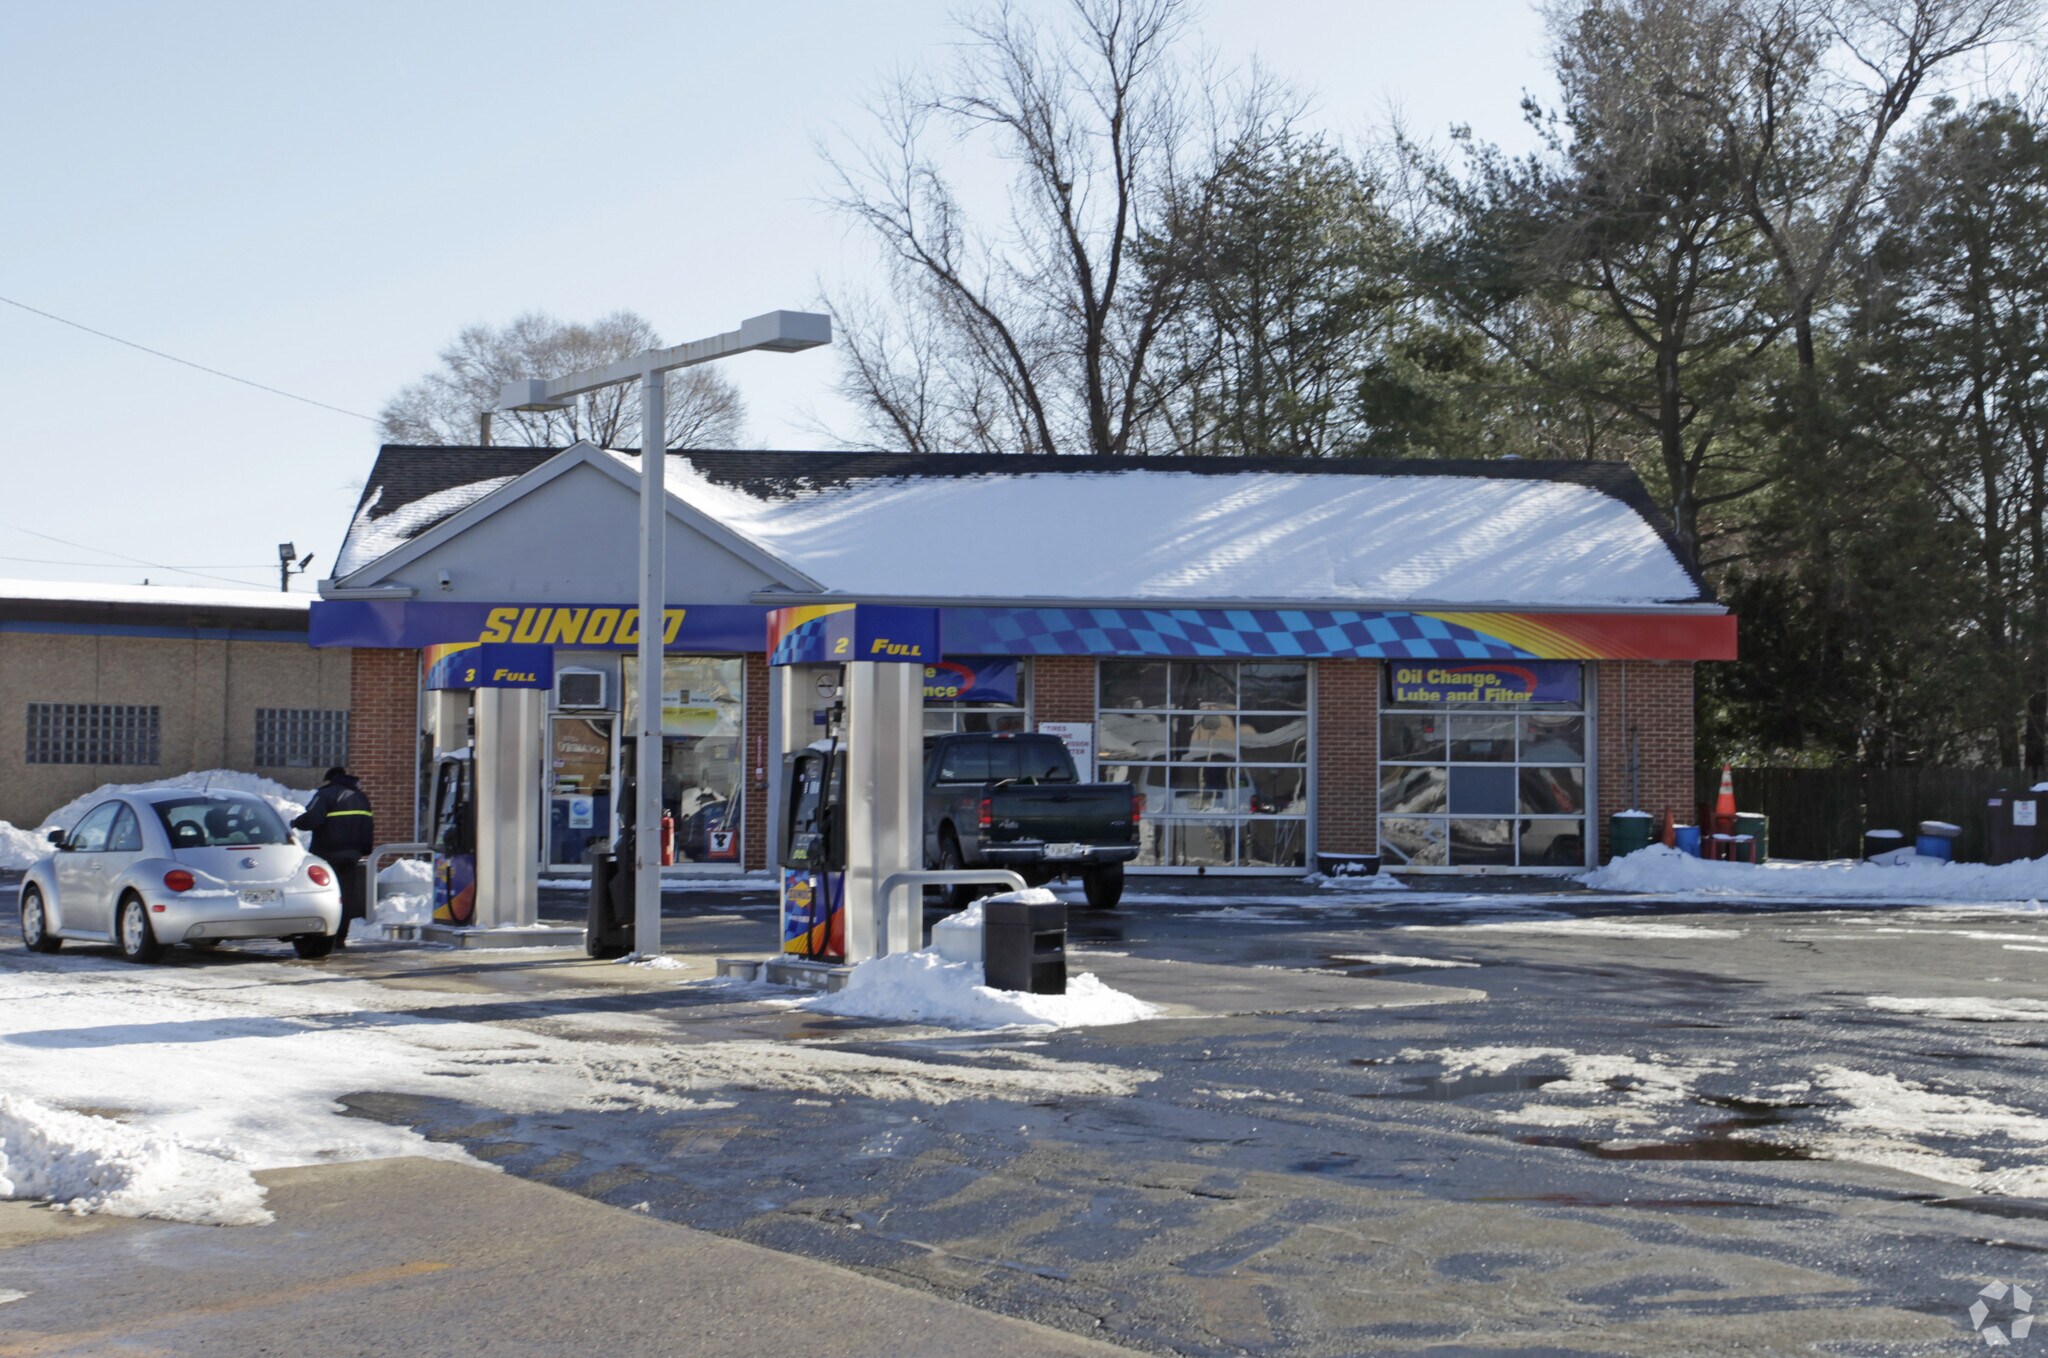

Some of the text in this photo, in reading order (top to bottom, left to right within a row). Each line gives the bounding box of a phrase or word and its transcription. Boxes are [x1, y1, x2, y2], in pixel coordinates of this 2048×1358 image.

[479, 607, 686, 644] SUNOCO
[834, 637, 849, 654] 2
[464, 668, 476, 682] 3
[1397, 668, 1501, 688] Oil Change,
[1397, 687, 1533, 703] Lube and Filter
